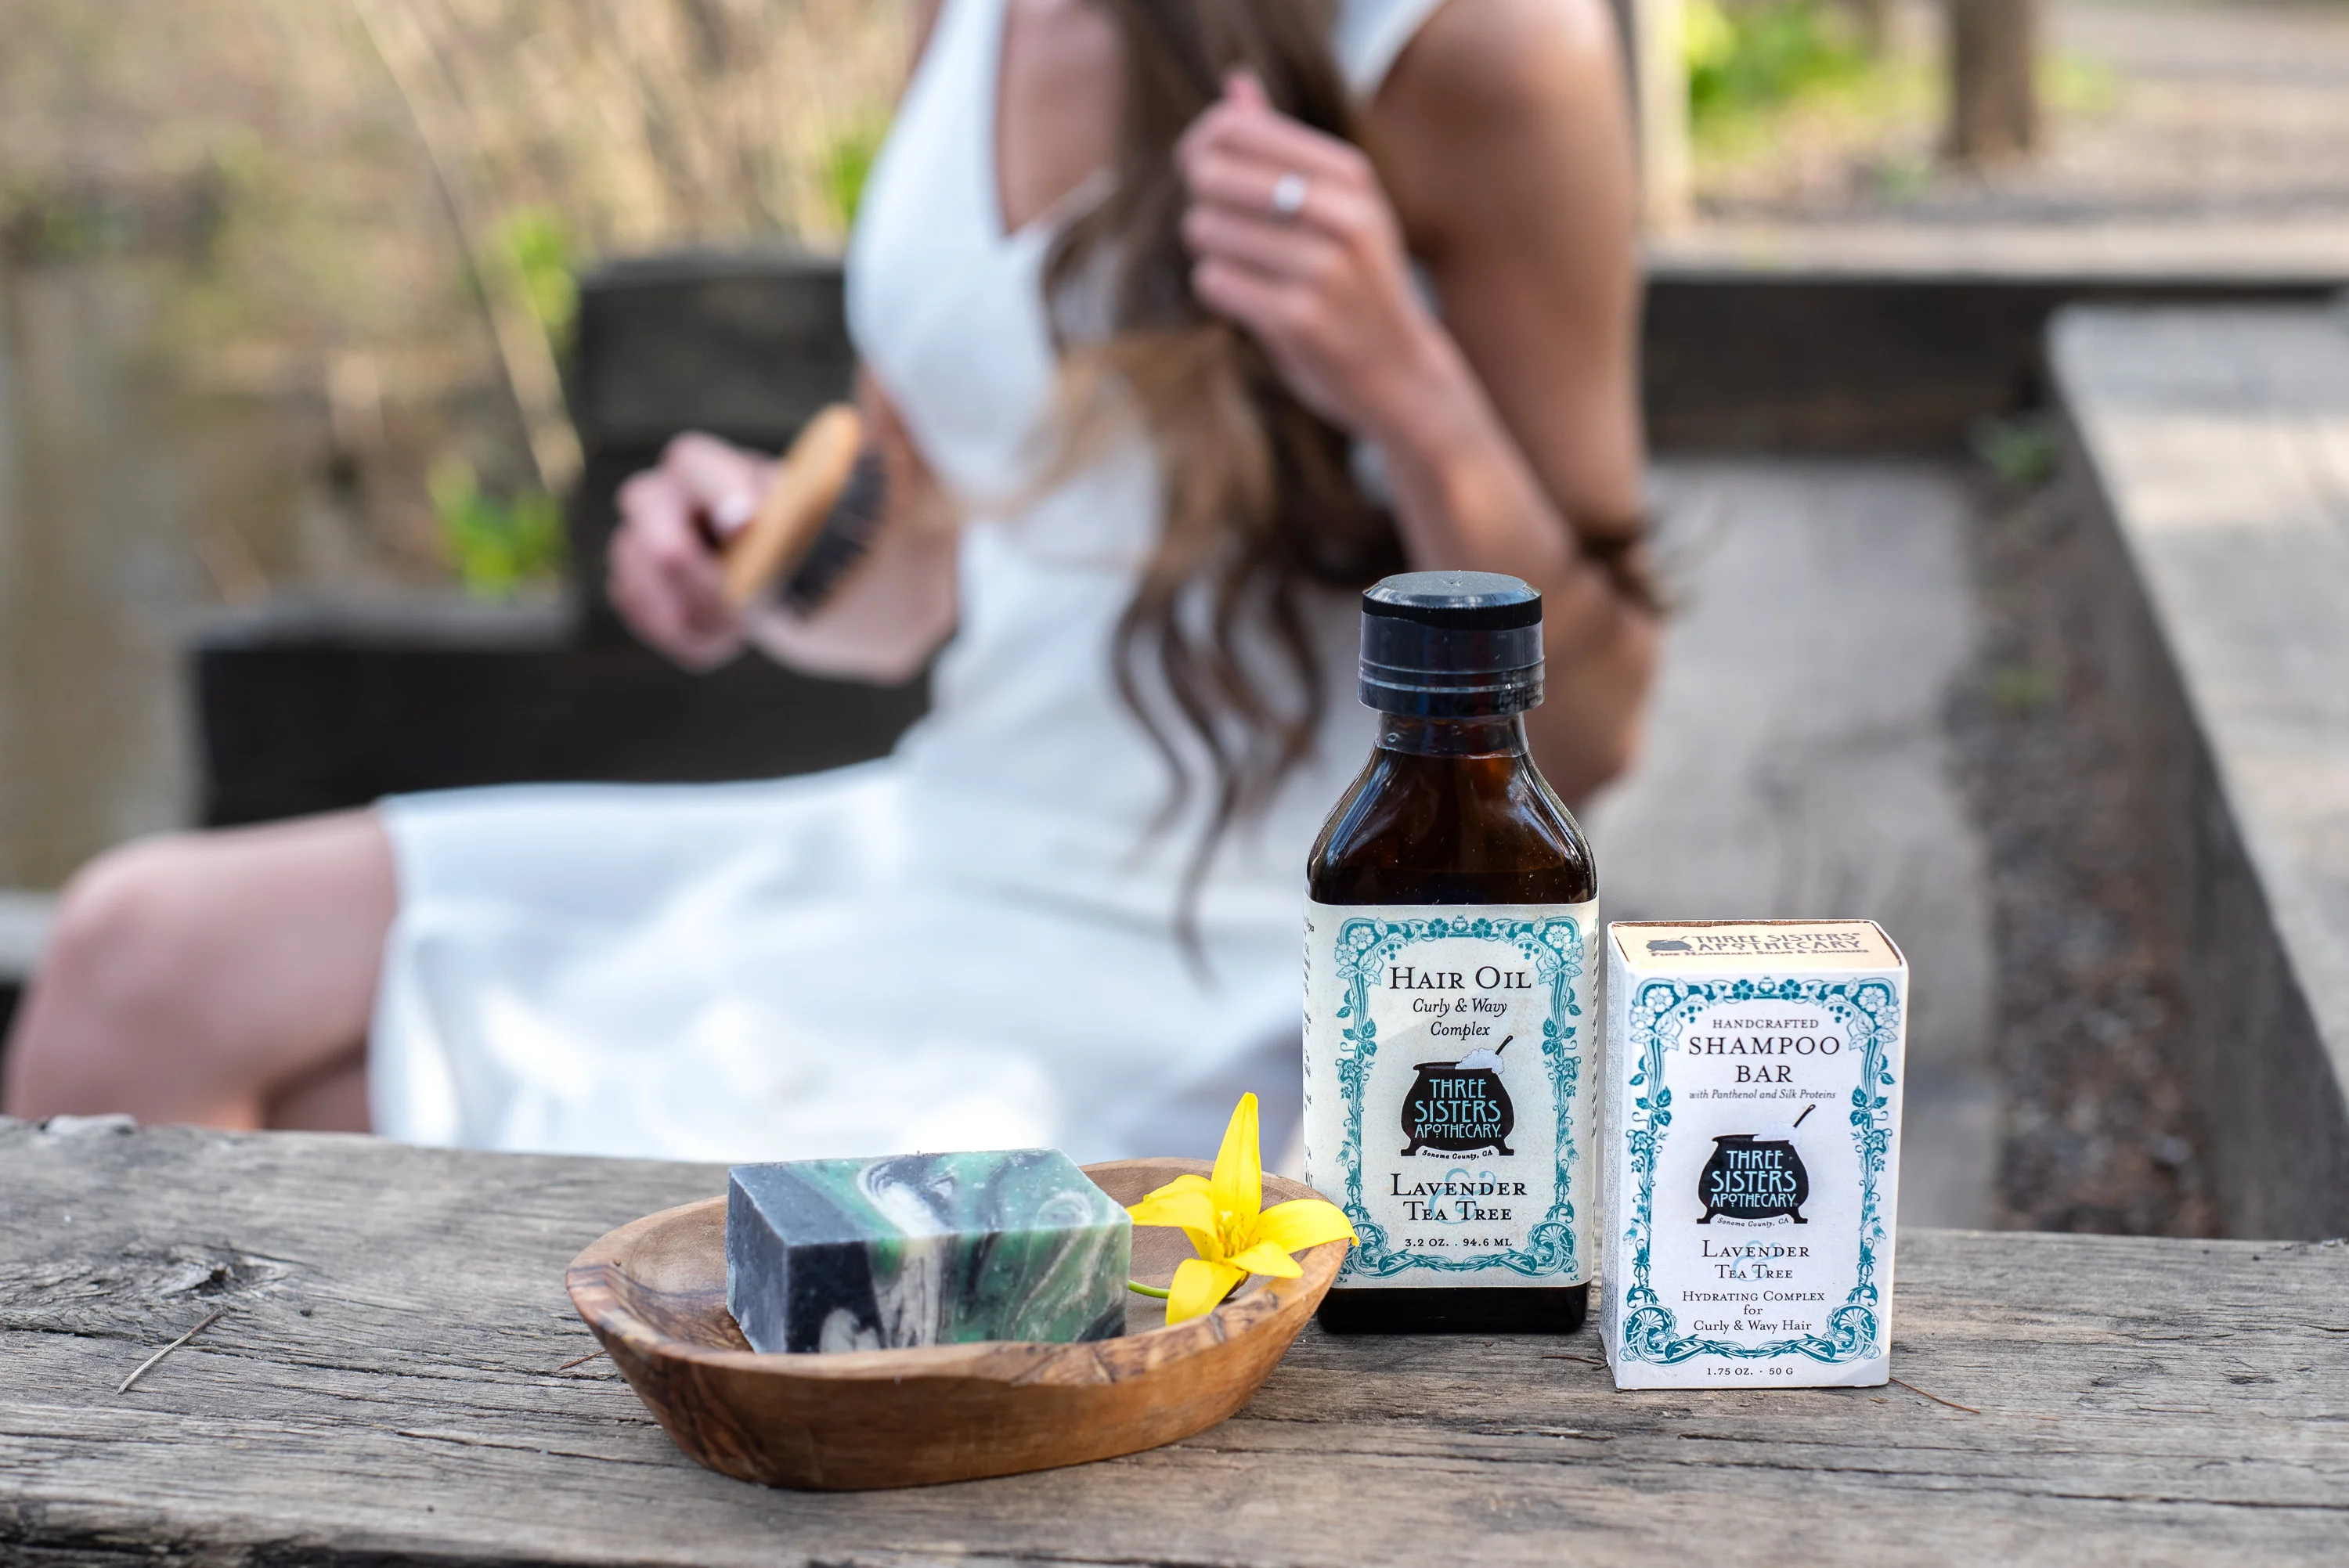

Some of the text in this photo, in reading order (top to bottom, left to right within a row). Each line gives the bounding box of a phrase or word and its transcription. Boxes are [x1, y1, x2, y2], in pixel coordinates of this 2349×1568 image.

[1413, 998, 1507, 1018] Curly & Wavy
[1431, 1021, 1491, 1041] Complex
[1712, 1018, 1819, 1029] HANDCRAFTED
[1688, 1036, 1840, 1055] SHAMPOO
[1735, 1065, 1794, 1083] BAR
[1429, 1079, 1487, 1098] THREE
[1689, 1089, 1836, 1099] with Panthenol and Silk Proteins
[1414, 1100, 1501, 1123] SISTERS
[1422, 1149, 1450, 1159] Sonoma
[1726, 1150, 1783, 1170] THREE
[1710, 1171, 1797, 1192] SISTERS
[1717, 1217, 1745, 1227] Sonoma
[1405, 1238, 1513, 1247] 3.2 OZ. 94.6 ML
[1743, 1304, 1763, 1315] for
[1693, 1320, 1812, 1333] Curly & Wavy Hair
[1707, 1367, 1794, 1376] 1.75 OZ. 50 G
